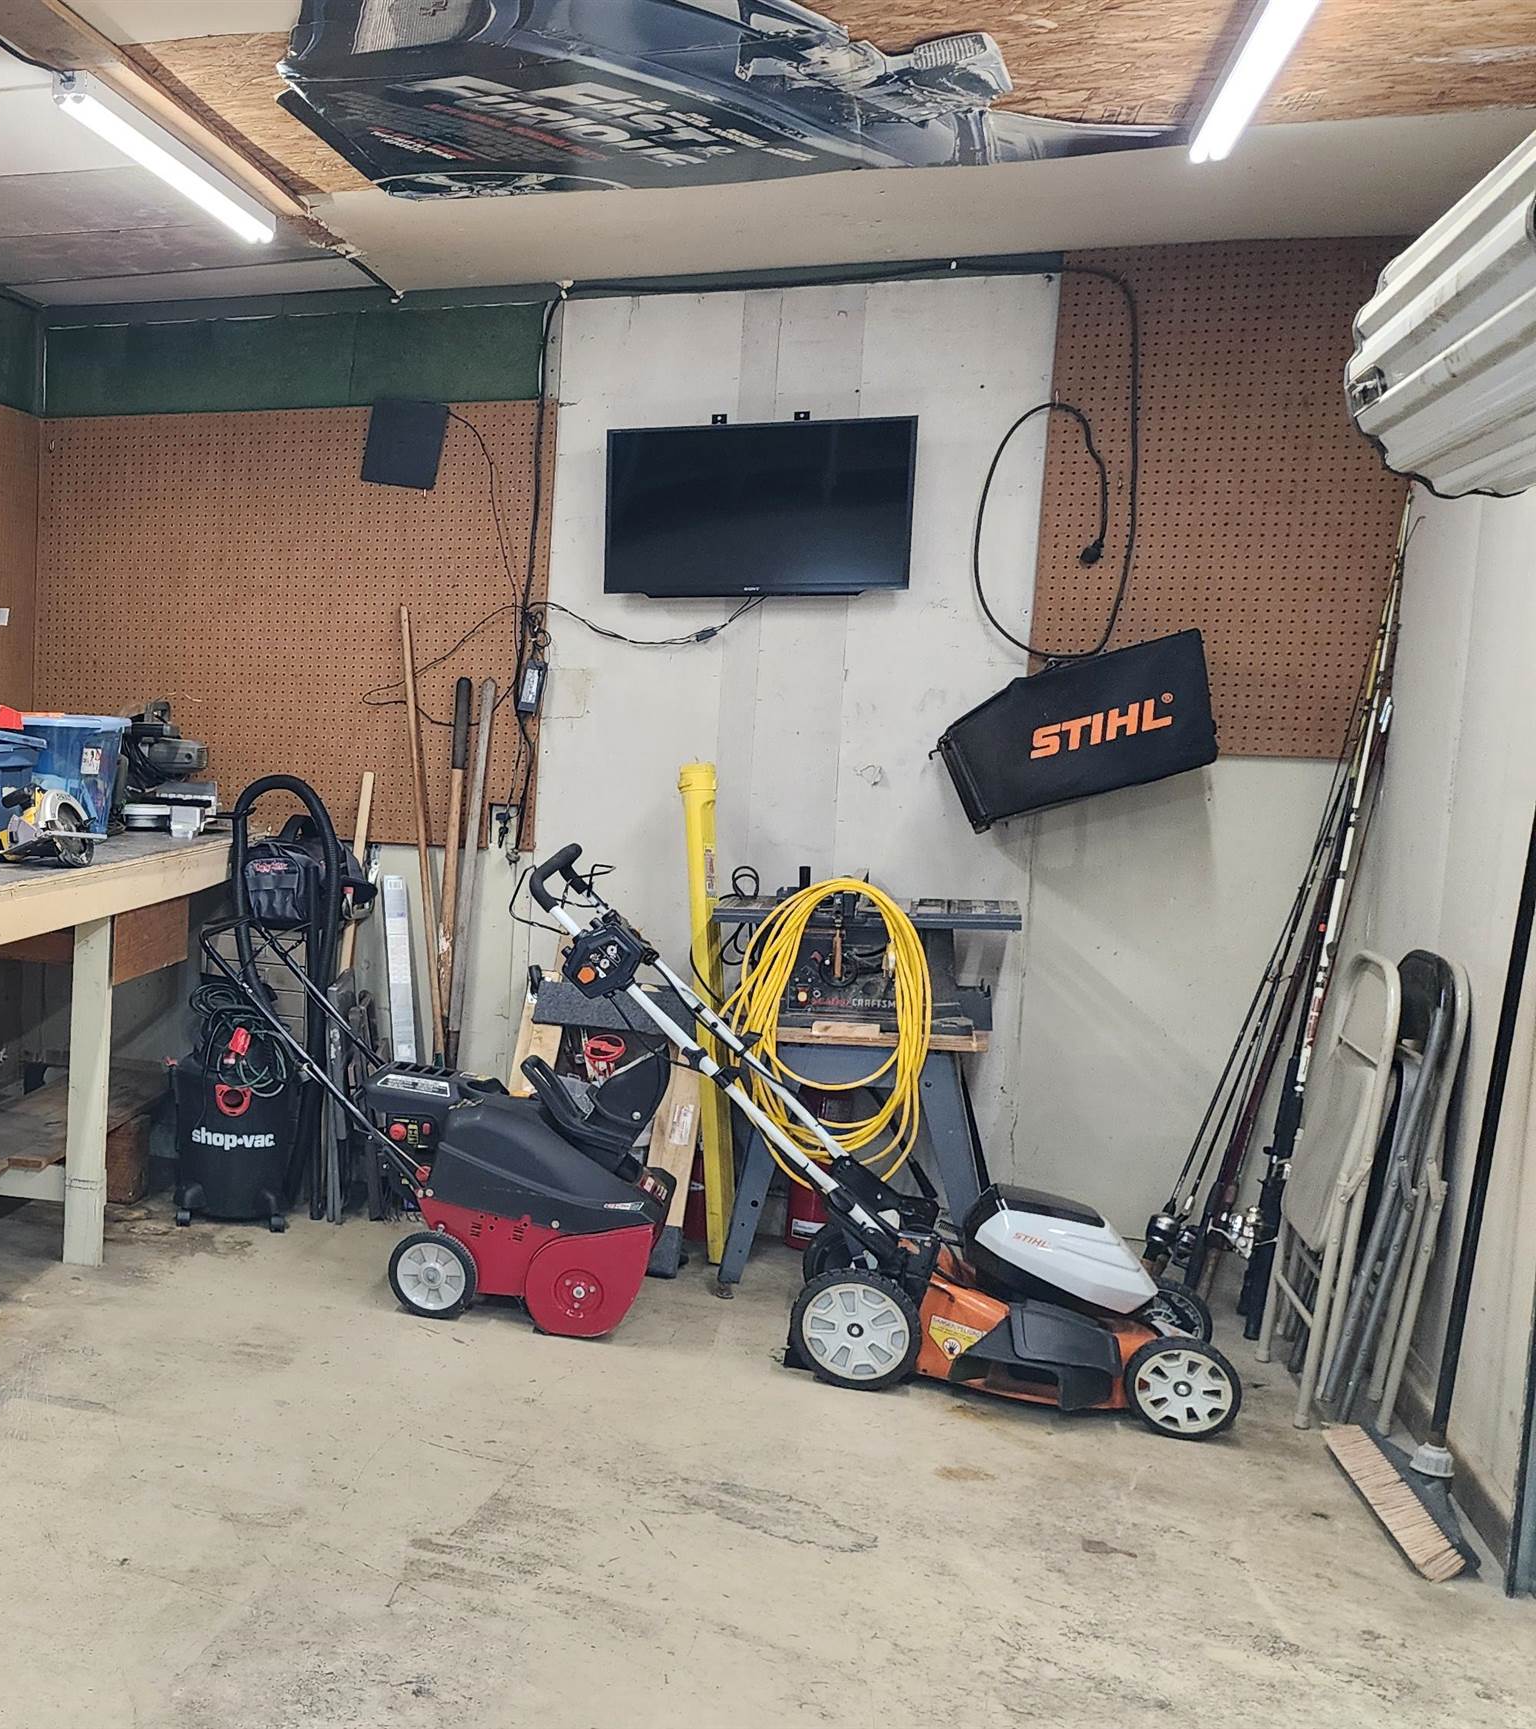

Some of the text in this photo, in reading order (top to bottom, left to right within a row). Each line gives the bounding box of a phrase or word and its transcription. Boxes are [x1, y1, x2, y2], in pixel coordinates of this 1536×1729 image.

[1030, 699, 1174, 759] STIHL
[851, 998, 896, 1008] CRAFTSM
[1013, 1232, 1049, 1248] STIHL
